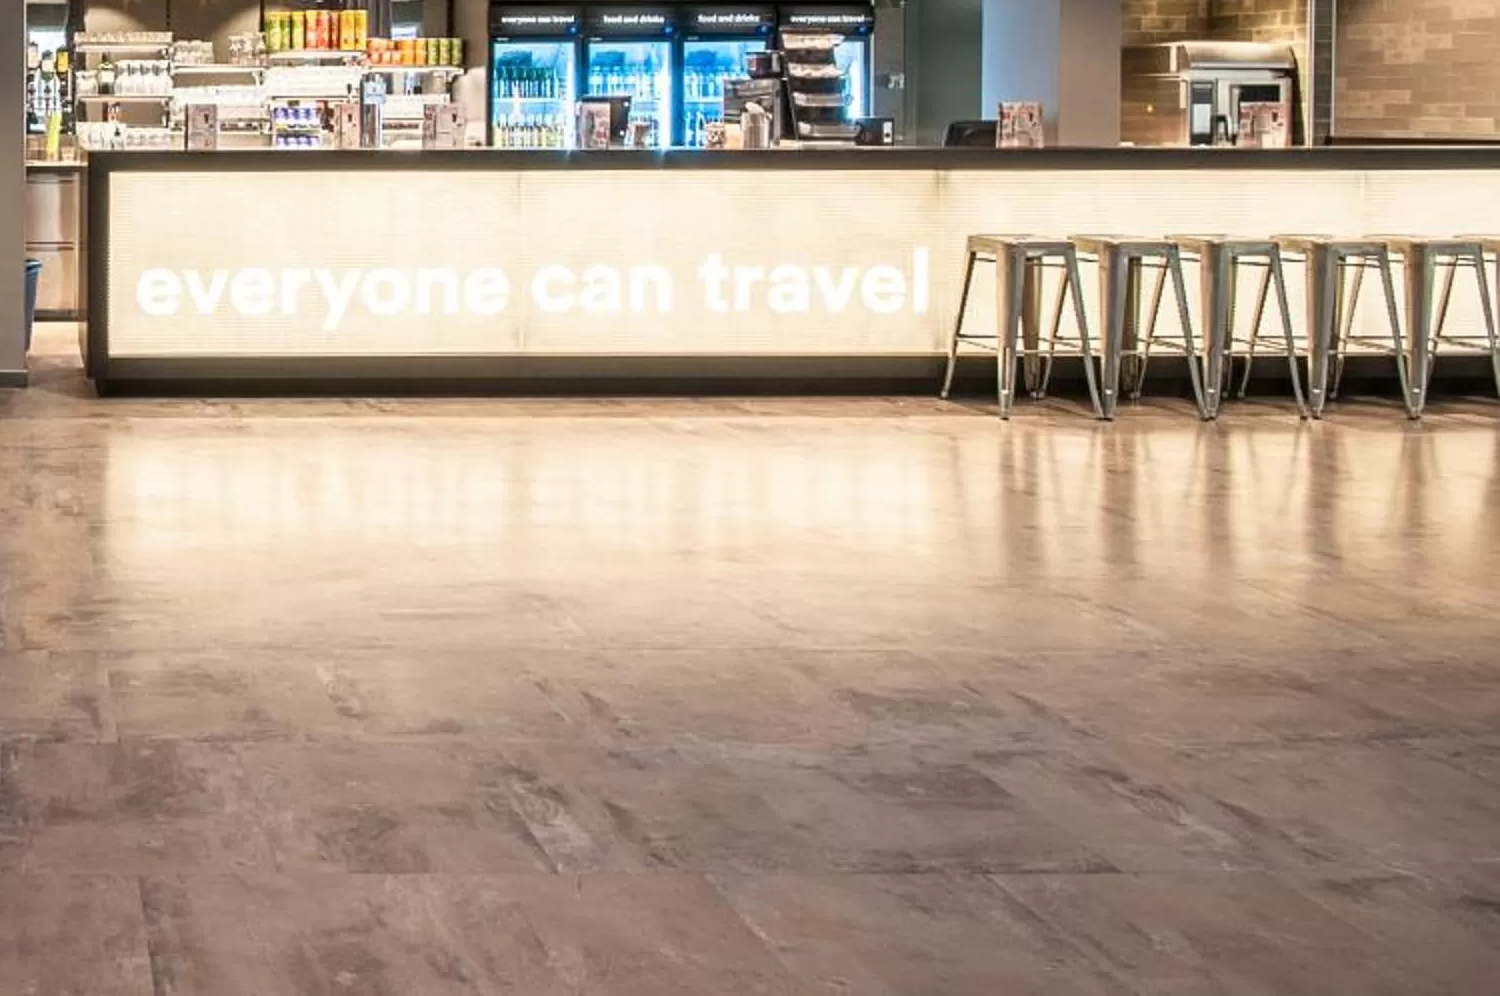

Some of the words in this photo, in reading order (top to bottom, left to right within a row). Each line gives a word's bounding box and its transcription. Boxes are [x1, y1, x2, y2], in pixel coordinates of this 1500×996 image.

[603, 14, 622, 23] food
[623, 14, 639, 23] and
[697, 14, 717, 23] food
[718, 14, 734, 23] and
[734, 14, 761, 23] drinks
[135, 264, 510, 331] everyone
[530, 262, 674, 316] can
[697, 246, 931, 314] travel
